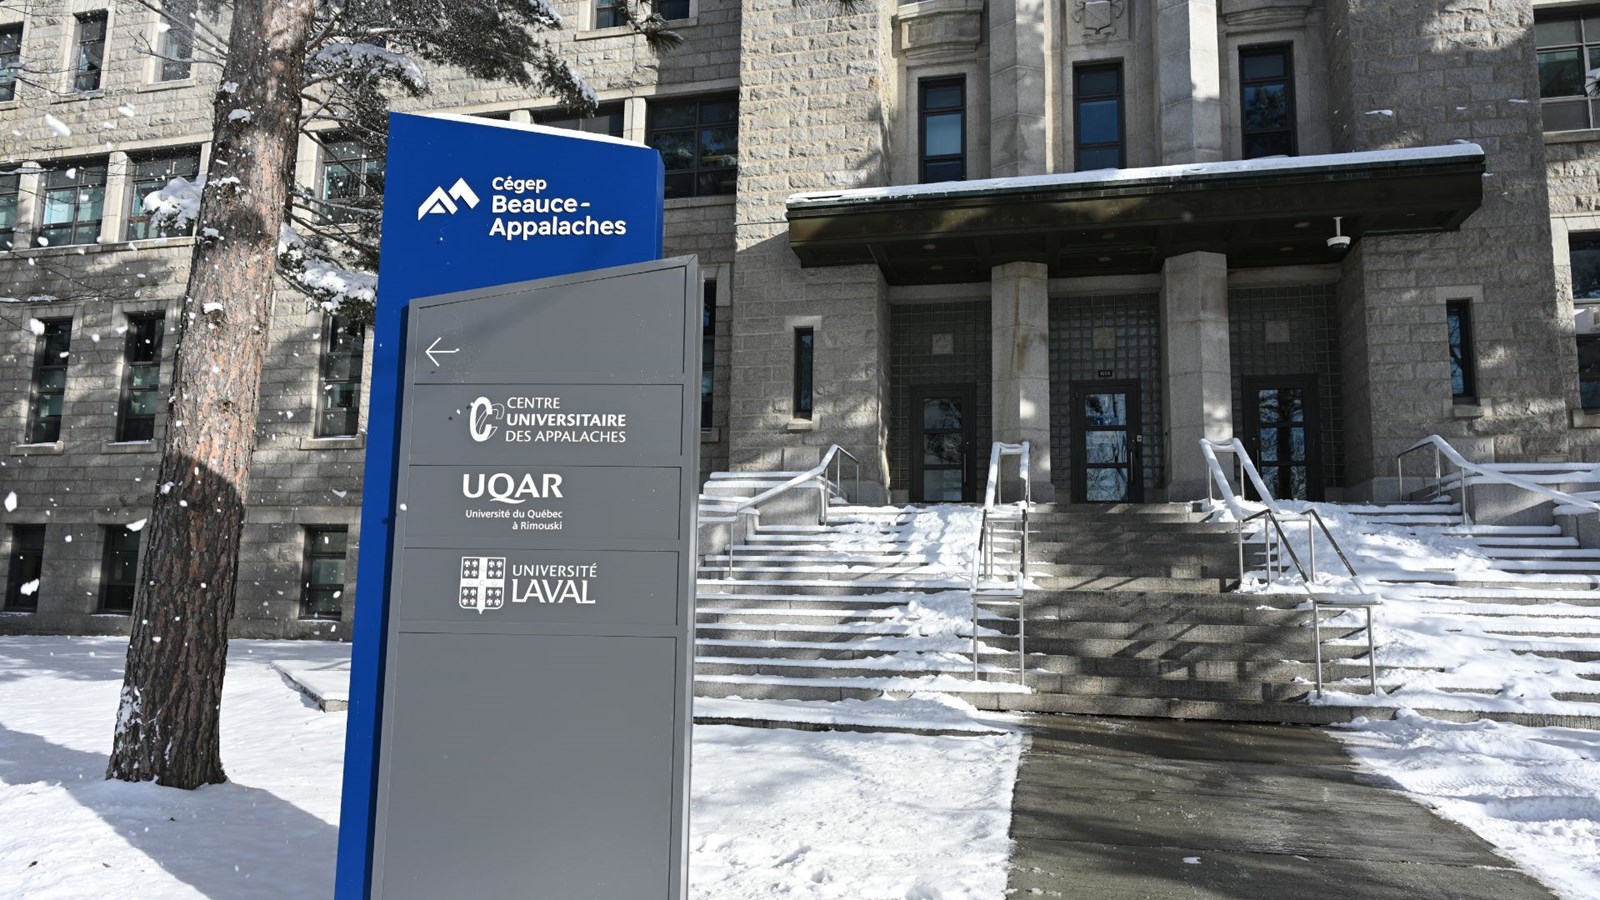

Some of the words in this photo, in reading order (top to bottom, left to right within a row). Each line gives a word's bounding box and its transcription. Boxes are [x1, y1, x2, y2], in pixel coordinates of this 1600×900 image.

[491, 176, 547, 194] Cégep
[491, 195, 591, 214] Beauce-
[489, 216, 627, 240] Appalaches
[506, 397, 560, 409] CENTRE
[506, 413, 627, 427] UNIVERSITAIRE
[505, 430, 532, 443] DES
[534, 430, 627, 443] APPALACHES
[462, 472, 564, 504] UQAR
[465, 509, 511, 519] Université
[512, 509, 525, 519] du
[527, 509, 563, 519] Québec
[512, 521, 518, 530] à
[520, 521, 563, 530] Rimouski
[512, 563, 598, 578] UNIVERSITÉ
[511, 578, 597, 604] LAVAL
